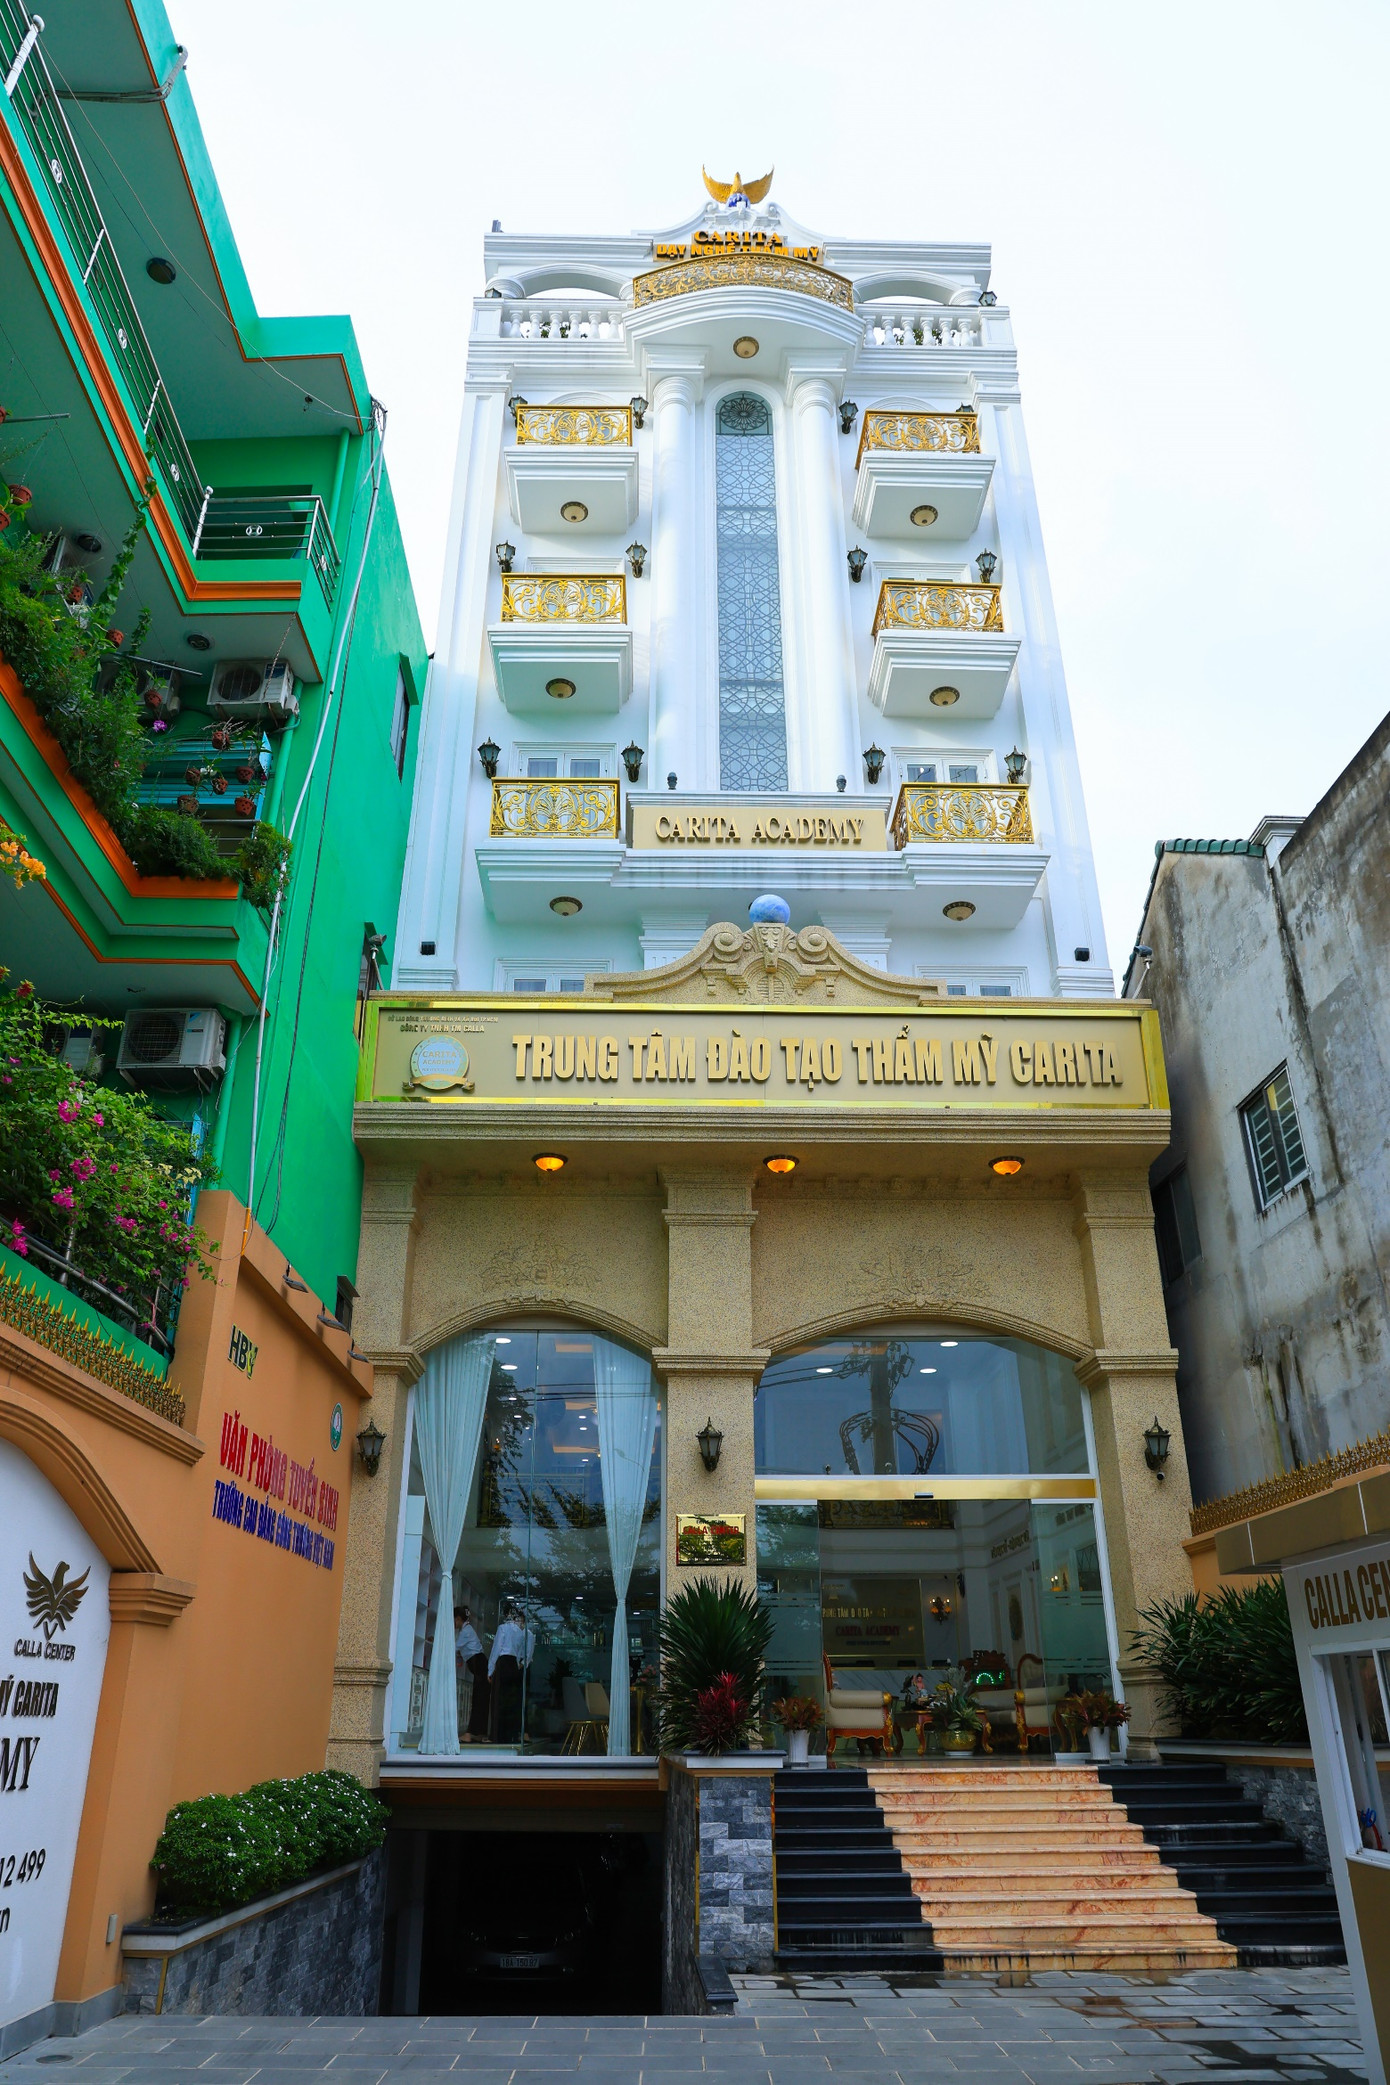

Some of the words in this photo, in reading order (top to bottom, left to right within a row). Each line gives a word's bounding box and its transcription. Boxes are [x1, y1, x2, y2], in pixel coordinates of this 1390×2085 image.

[656, 244, 687, 258] DẠY
[793, 244, 820, 261] MỸ
[694, 230, 783, 247] CARITA
[655, 815, 741, 842] CARITA
[751, 815, 865, 844] ACADEMY
[463, 1024, 485, 1033] CALLA
[422, 1050, 457, 1058] CARITA
[512, 1034, 619, 1080] TRUNG
[628, 1027, 696, 1083] TÂM
[706, 1029, 772, 1082] ĐÀO
[780, 1037, 842, 1092] TẠO
[852, 1024, 943, 1084] THẨM
[951, 1032, 999, 1086] MỸ
[1010, 1039, 1124, 1086] CARITA
[220, 1409, 248, 1478] VĂN
[247, 1434, 287, 1501] PHÒNG
[287, 1457, 318, 1520] TUYỂN
[317, 1480, 339, 1532] SINH
[243, 1495, 259, 1535] CAO
[1304, 1569, 1362, 1630] CALLA
[14, 1638, 42, 1658] CALLA
[44, 1641, 76, 1662] CENTER
[12, 1680, 60, 1718] CARITA
[16, 1848, 46, 1884] 499
